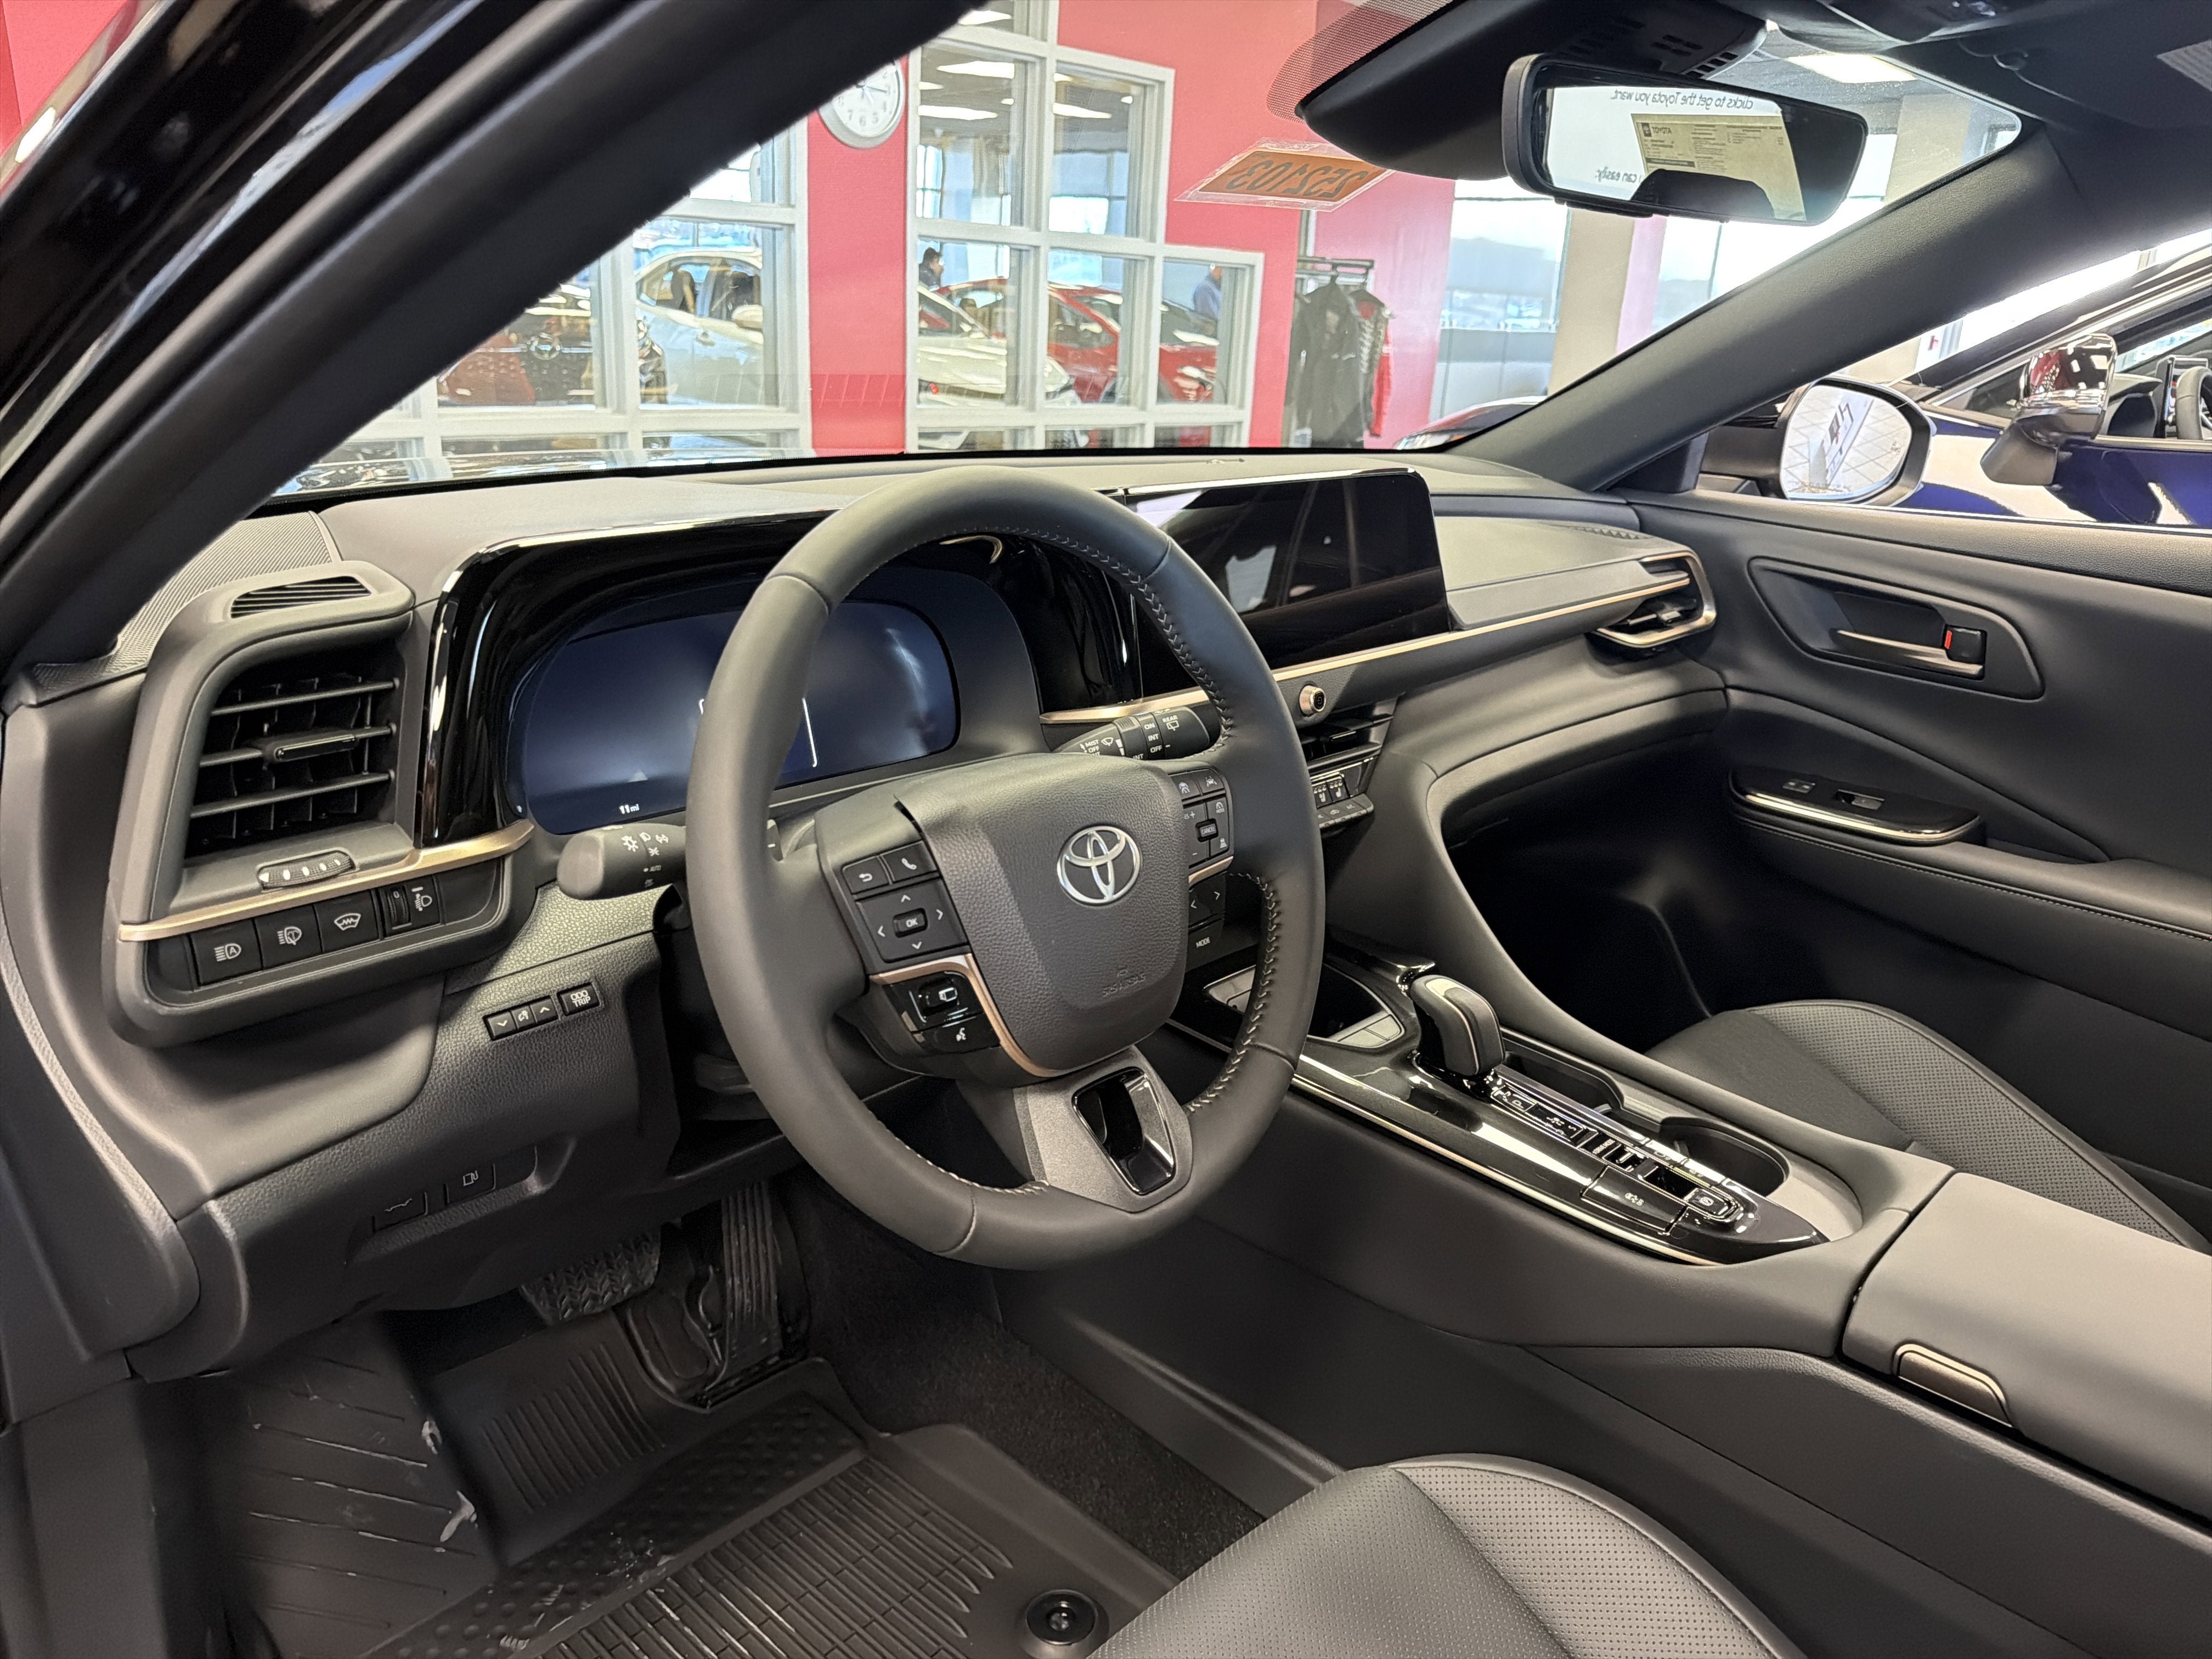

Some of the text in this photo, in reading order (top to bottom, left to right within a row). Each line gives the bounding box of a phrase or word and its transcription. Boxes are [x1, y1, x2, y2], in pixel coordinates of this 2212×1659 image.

[1162, 715, 1179, 723] REAR
[1085, 739, 1099, 748] MIST
[1088, 746, 1100, 754] OFF
[1150, 745, 1163, 753] OFF
[1200, 826, 1217, 835] CANCEL
[906, 918, 918, 928] OK
[1196, 936, 1211, 949] MODE
[570, 990, 589, 1001] ODO
[572, 996, 591, 1007] TRIP
